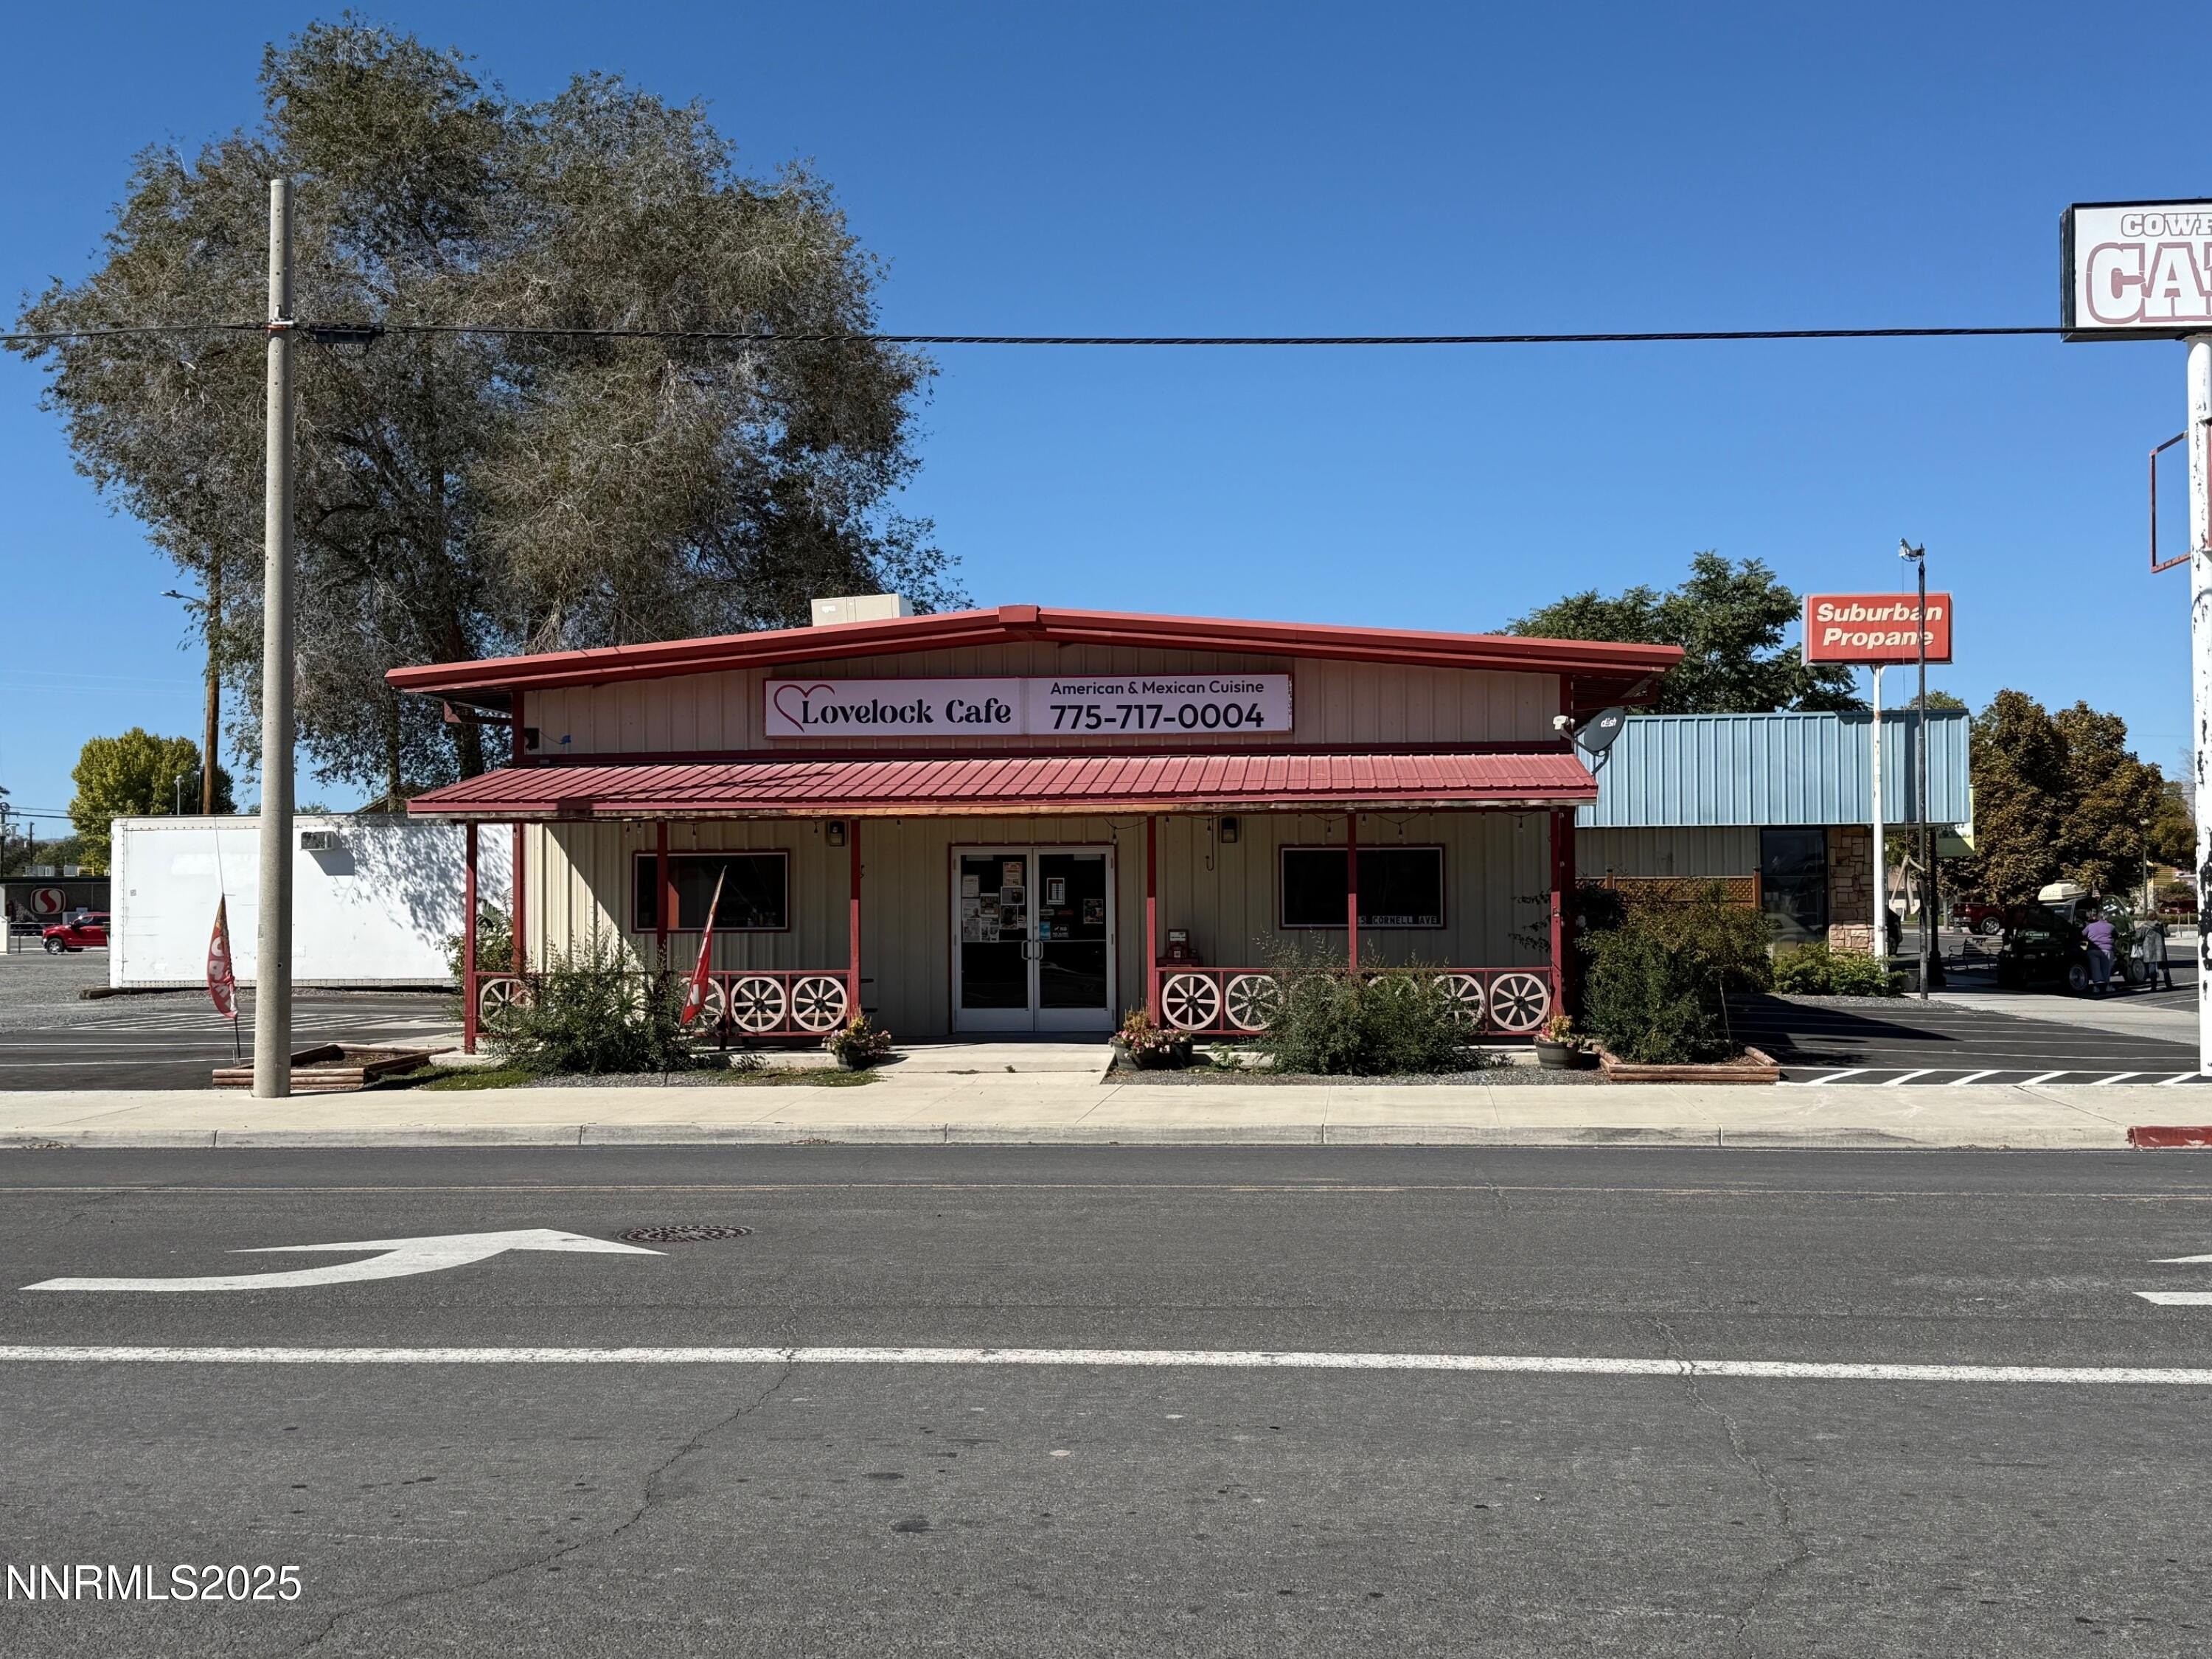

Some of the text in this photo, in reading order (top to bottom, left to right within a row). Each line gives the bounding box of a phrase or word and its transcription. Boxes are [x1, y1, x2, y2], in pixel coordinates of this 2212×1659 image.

[2086, 242, 2212, 324] CA
[1816, 602, 1943, 622] Suburban
[1823, 627, 1935, 650] Propane
[1050, 680, 1265, 695] American & Mexican Cuisine
[801, 698, 1012, 724] Lovelock Cafe
[1050, 703, 1265, 729] 775-717-0004
[1373, 916, 1412, 925] CORNELL
[1419, 916, 1437, 925] AVE
